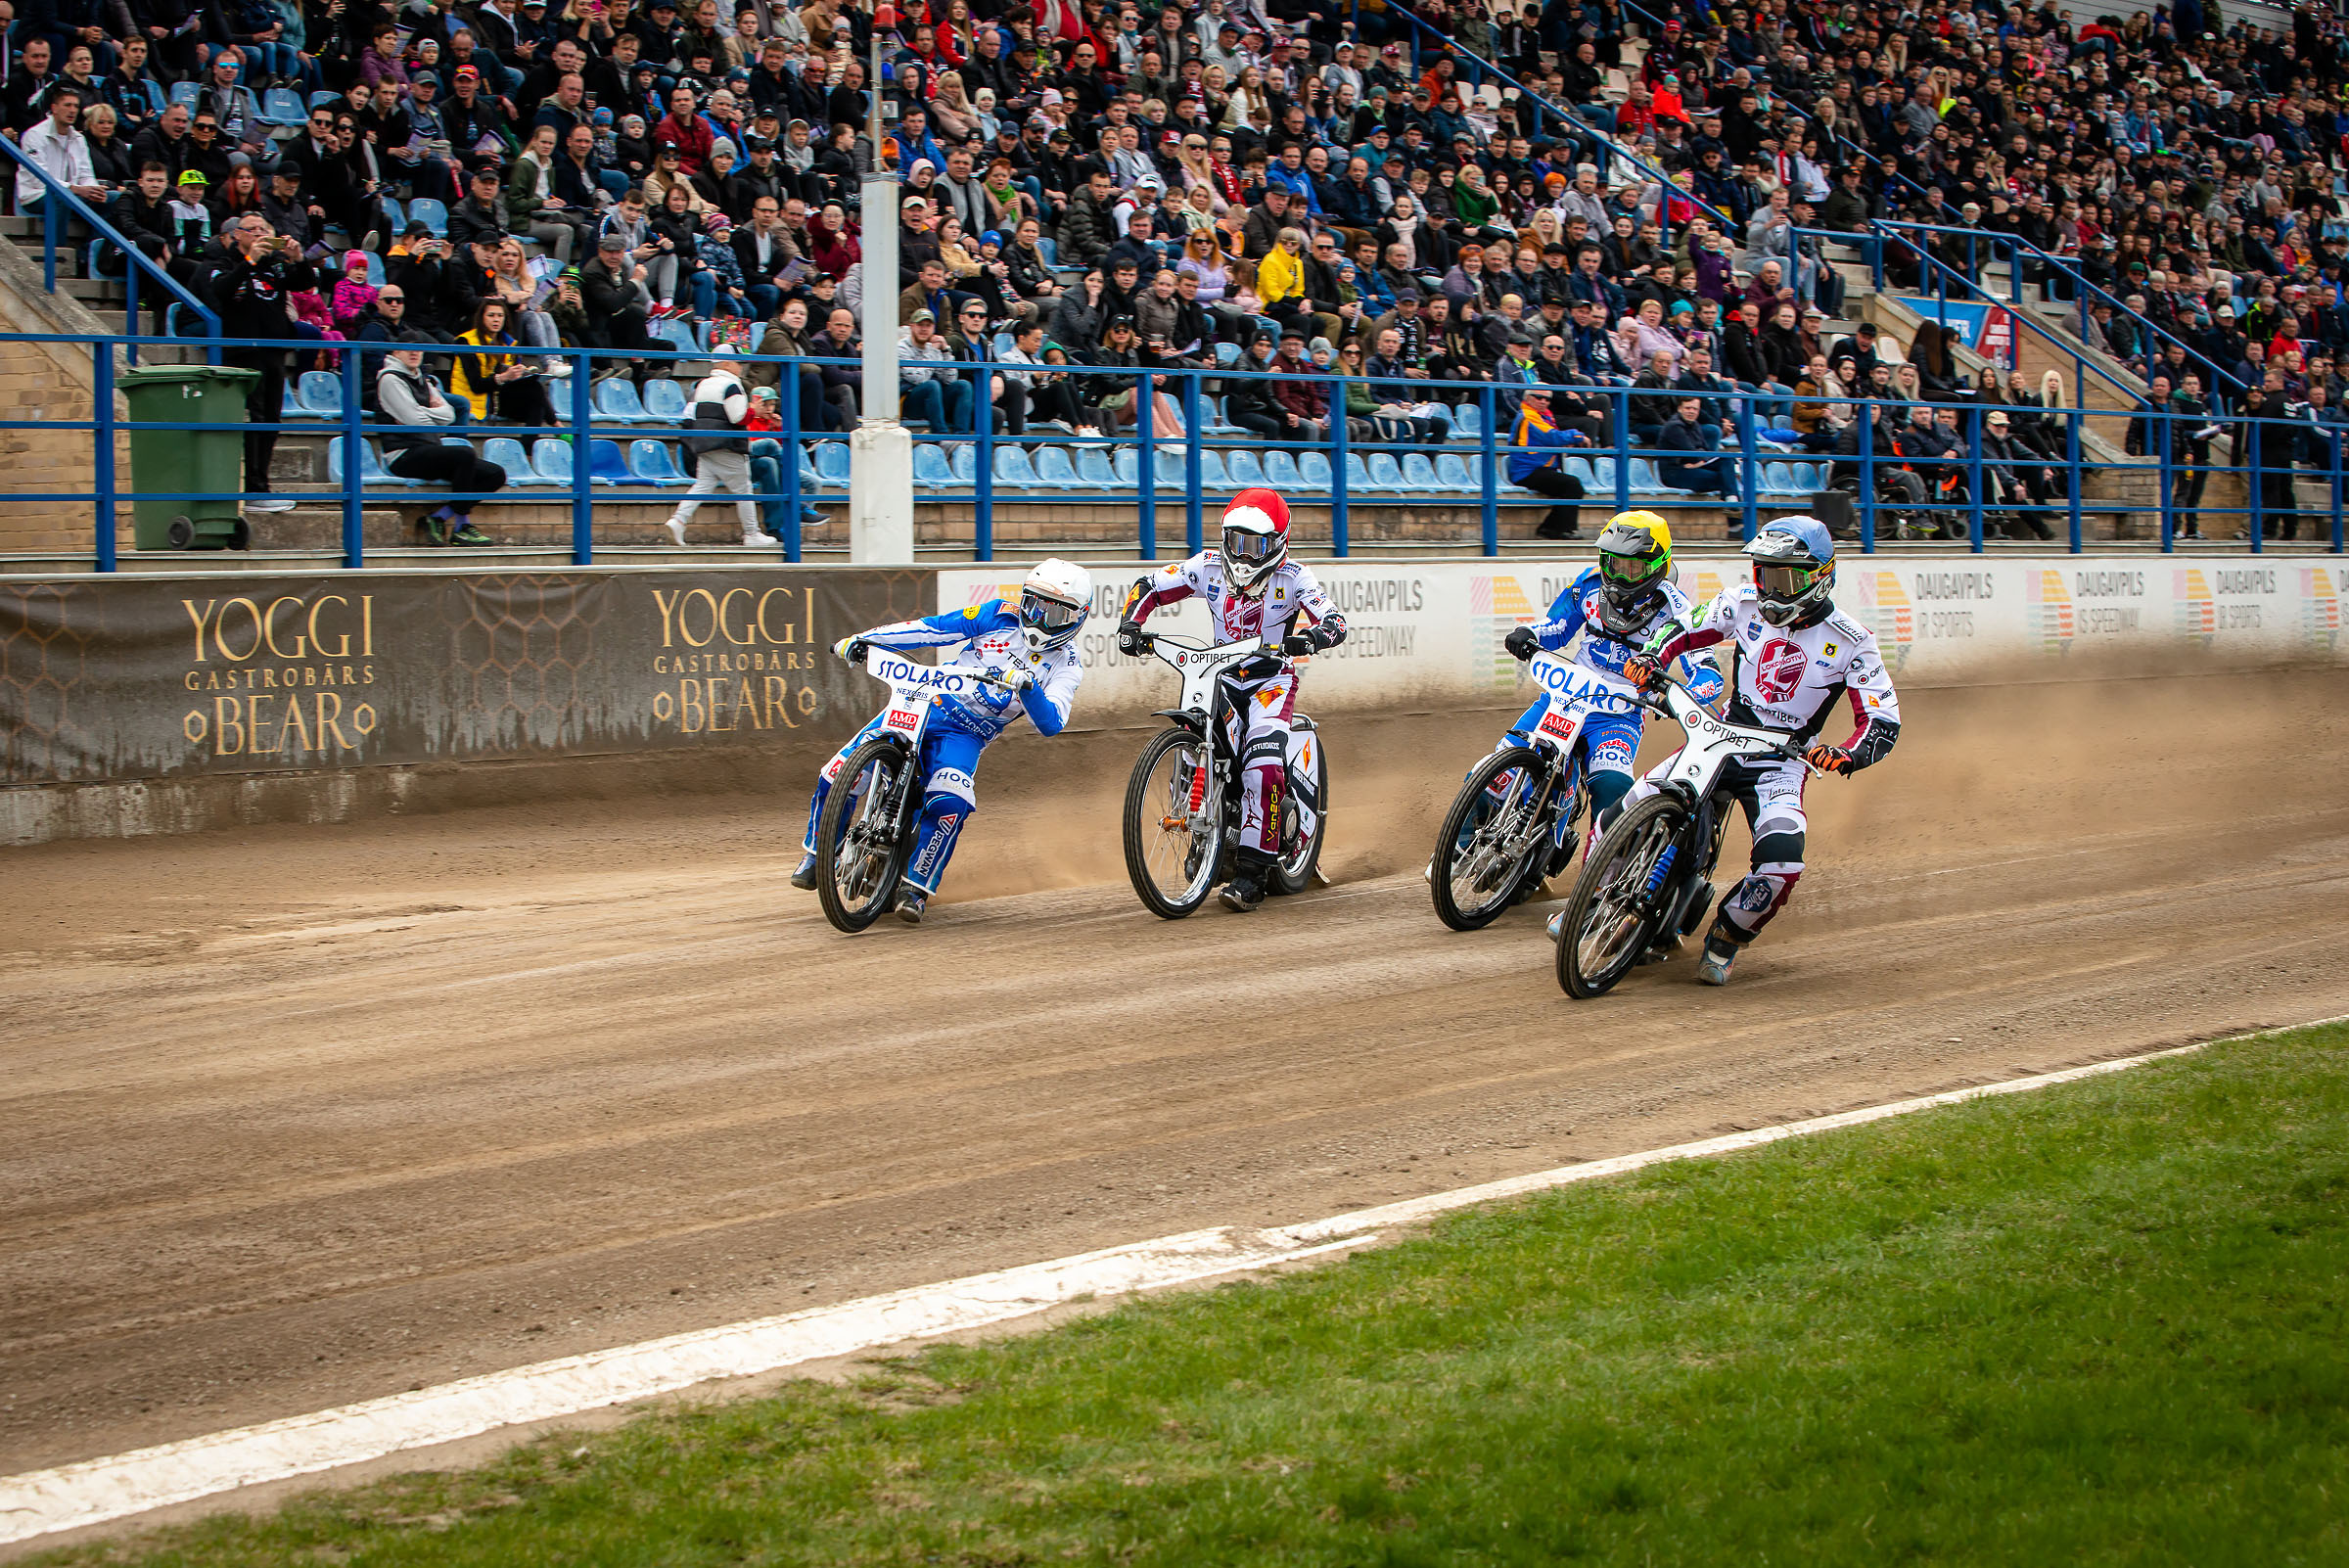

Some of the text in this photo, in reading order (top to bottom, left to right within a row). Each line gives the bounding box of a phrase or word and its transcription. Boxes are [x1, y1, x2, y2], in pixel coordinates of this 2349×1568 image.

[182, 595, 374, 662] YOGGI
[652, 587, 815, 647] YOGGI
[654, 650, 815, 673] GASTROBĀRS
[1191, 653, 1232, 665] OPTIBET
[185, 664, 374, 690] GASTROBĀRS
[878, 661, 964, 692] STOLARO
[679, 676, 800, 733] BEAR
[890, 712, 918, 725] AMD
[214, 692, 357, 756] BEAR
[1544, 715, 1574, 732] AMD
[1704, 721, 1752, 751] OPTIBET
[938, 771, 972, 789] HOG
[919, 831, 944, 877] PEGWAN
